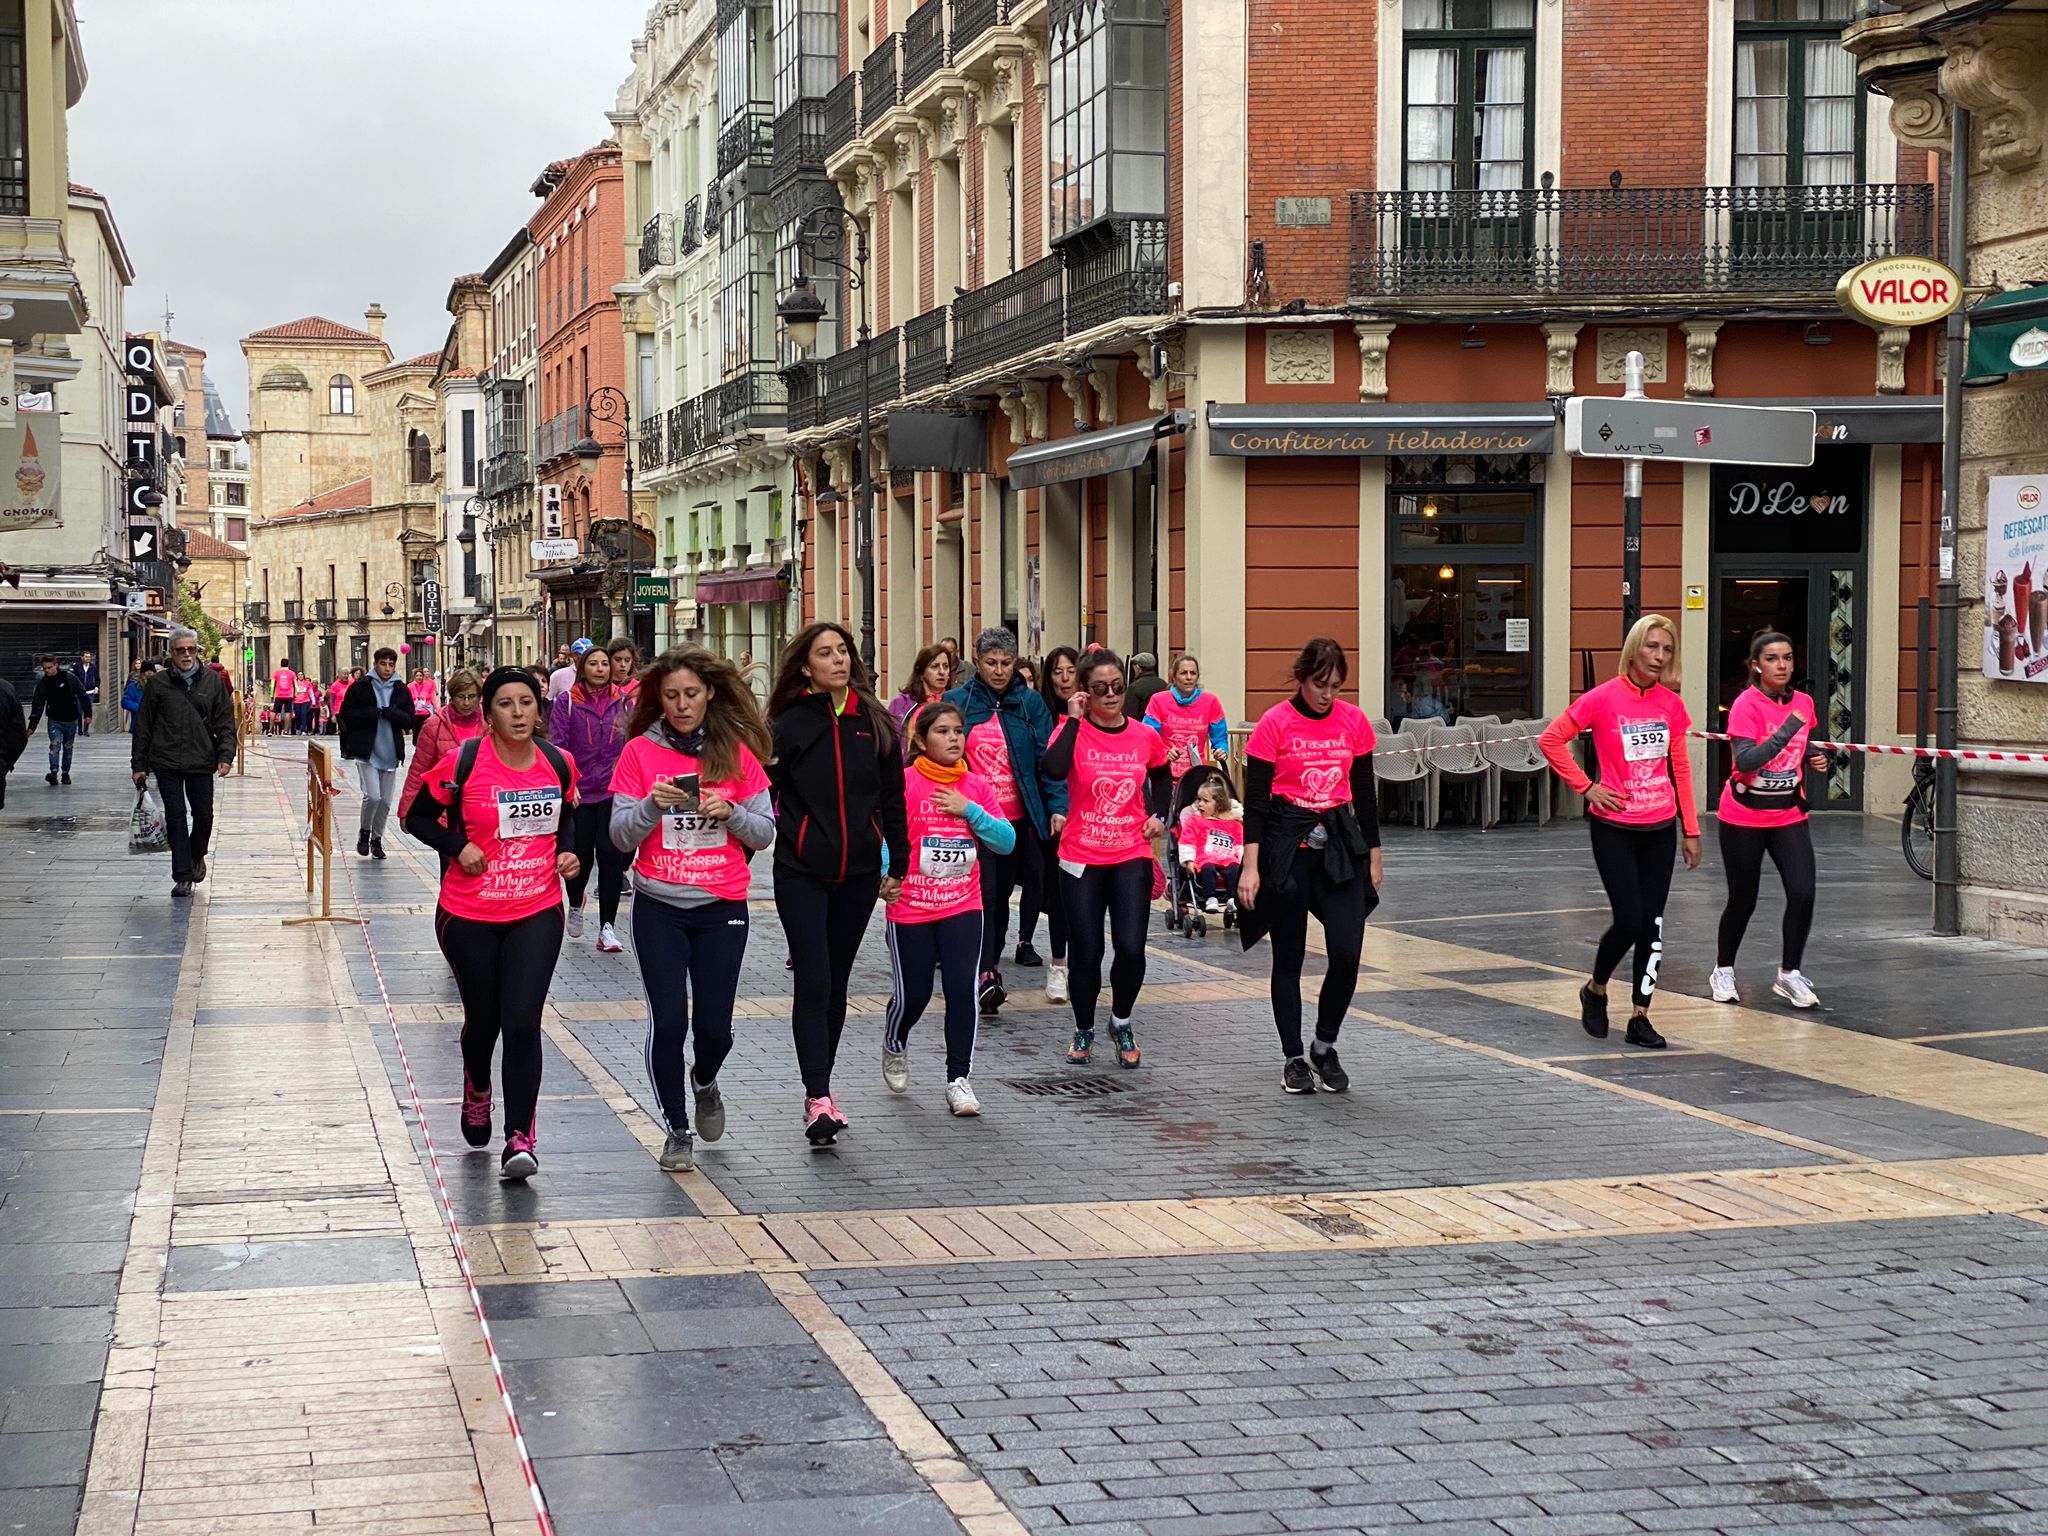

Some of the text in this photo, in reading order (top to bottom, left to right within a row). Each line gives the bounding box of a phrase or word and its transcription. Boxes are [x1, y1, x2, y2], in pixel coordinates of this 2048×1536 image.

[1877, 263, 1932, 274] CHOCOLATES
[1860, 279, 1949, 304] VALOR
[1230, 430, 1532, 453] Confitería Heladería
[2020, 493, 2039, 502] VALOR
[3, 507, 54, 517] GNOMOS
[546, 487, 561, 537] IRIS
[637, 584, 669, 597] JOYERIA
[426, 583, 438, 624] HOTEL
[1631, 732, 1665, 746] 5392
[509, 802, 553, 819] 2586
[673, 816, 719, 831] 3372
[499, 856, 548, 871] CARRERA
[673, 854, 727, 867] CARRERA
[931, 849, 967, 863] 3371
[492, 873, 535, 892] Mujer
[667, 866, 714, 885] Mujer
[920, 888, 960, 902] Mujer
